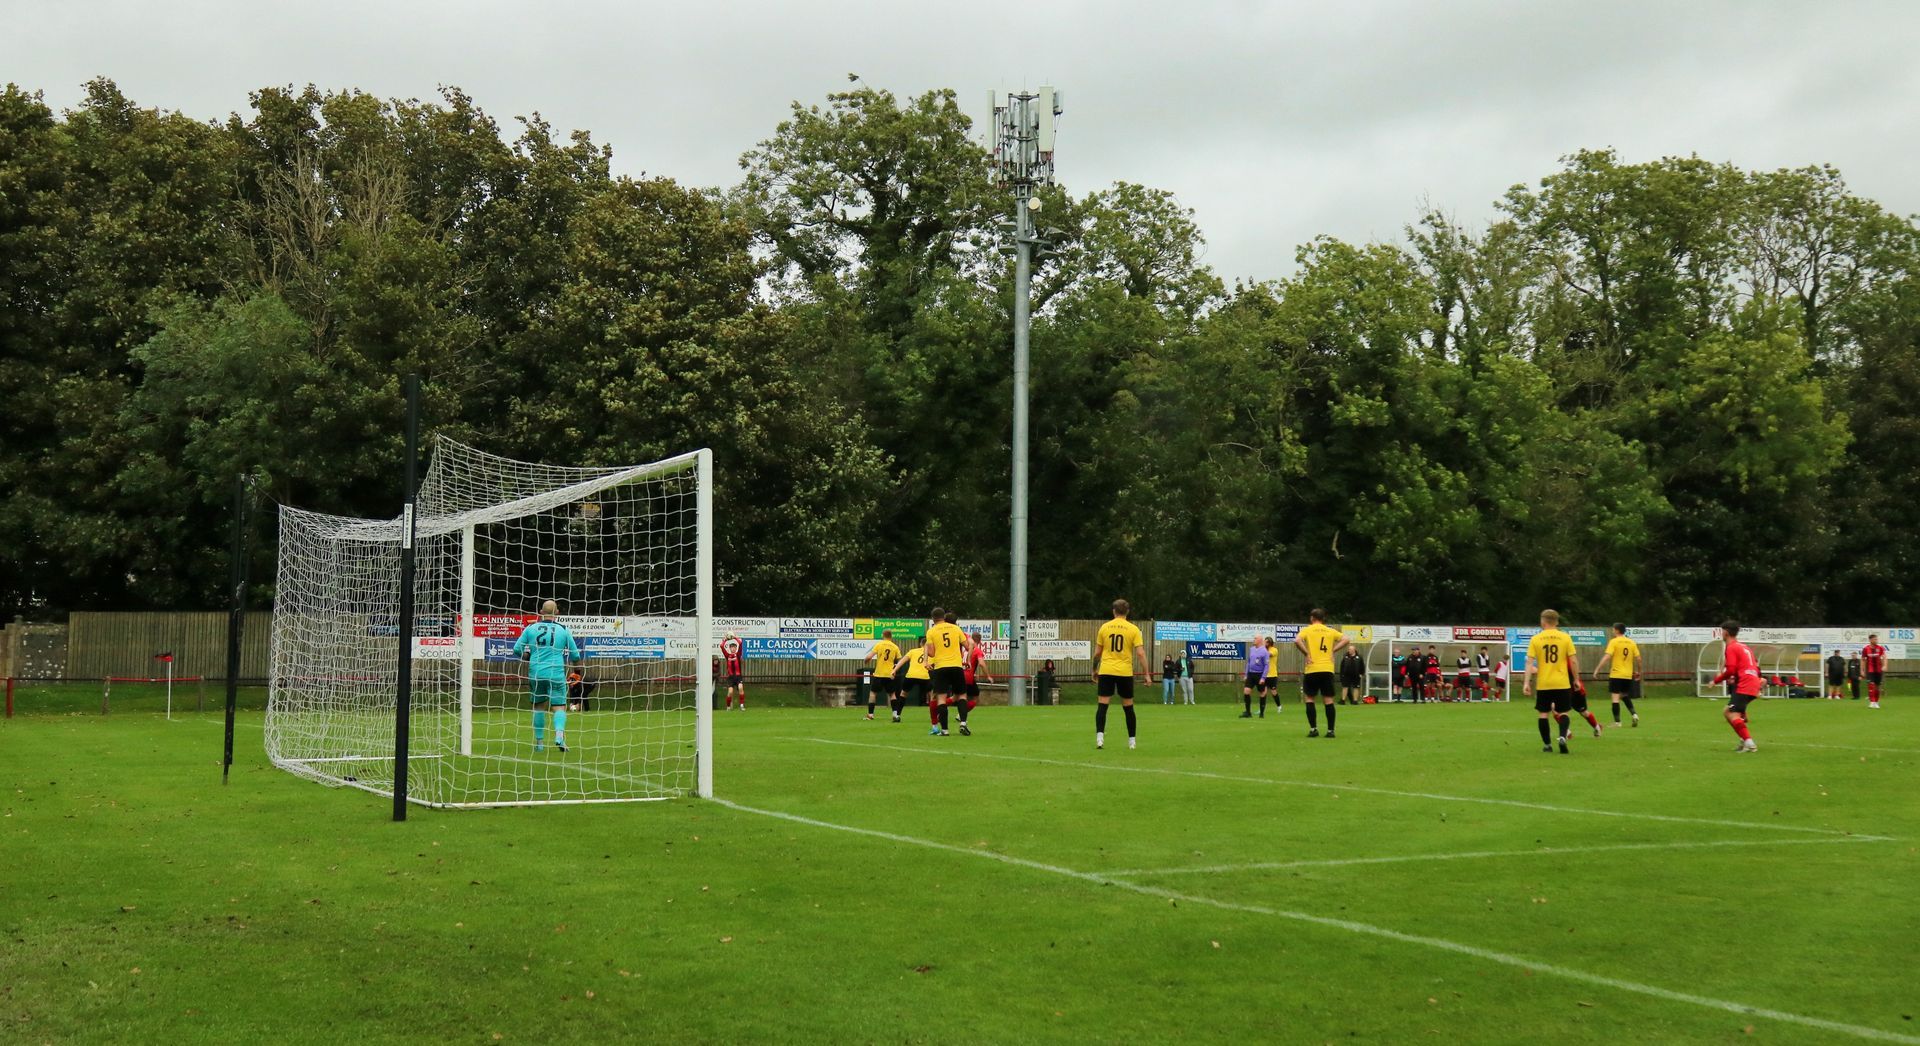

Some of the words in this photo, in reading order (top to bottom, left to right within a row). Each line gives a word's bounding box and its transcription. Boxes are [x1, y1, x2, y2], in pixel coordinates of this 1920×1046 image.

[491, 616, 515, 624] NIVEN
[601, 616, 616, 624] You
[783, 619, 801, 628] C.S.
[803, 619, 850, 628] McKERLIE
[969, 624, 982, 633] Hire
[982, 623, 992, 633] Ltd
[1898, 629, 1915, 639] RBS
[536, 625, 555, 647] 21
[942, 632, 951, 648] 5
[1109, 633, 1124, 653] 10
[766, 640, 809, 649] CARSON
[1319, 636, 1328, 653] 4
[883, 648, 891, 662] 3
[1542, 644, 1559, 664] 18
[1622, 647, 1629, 661] 9
